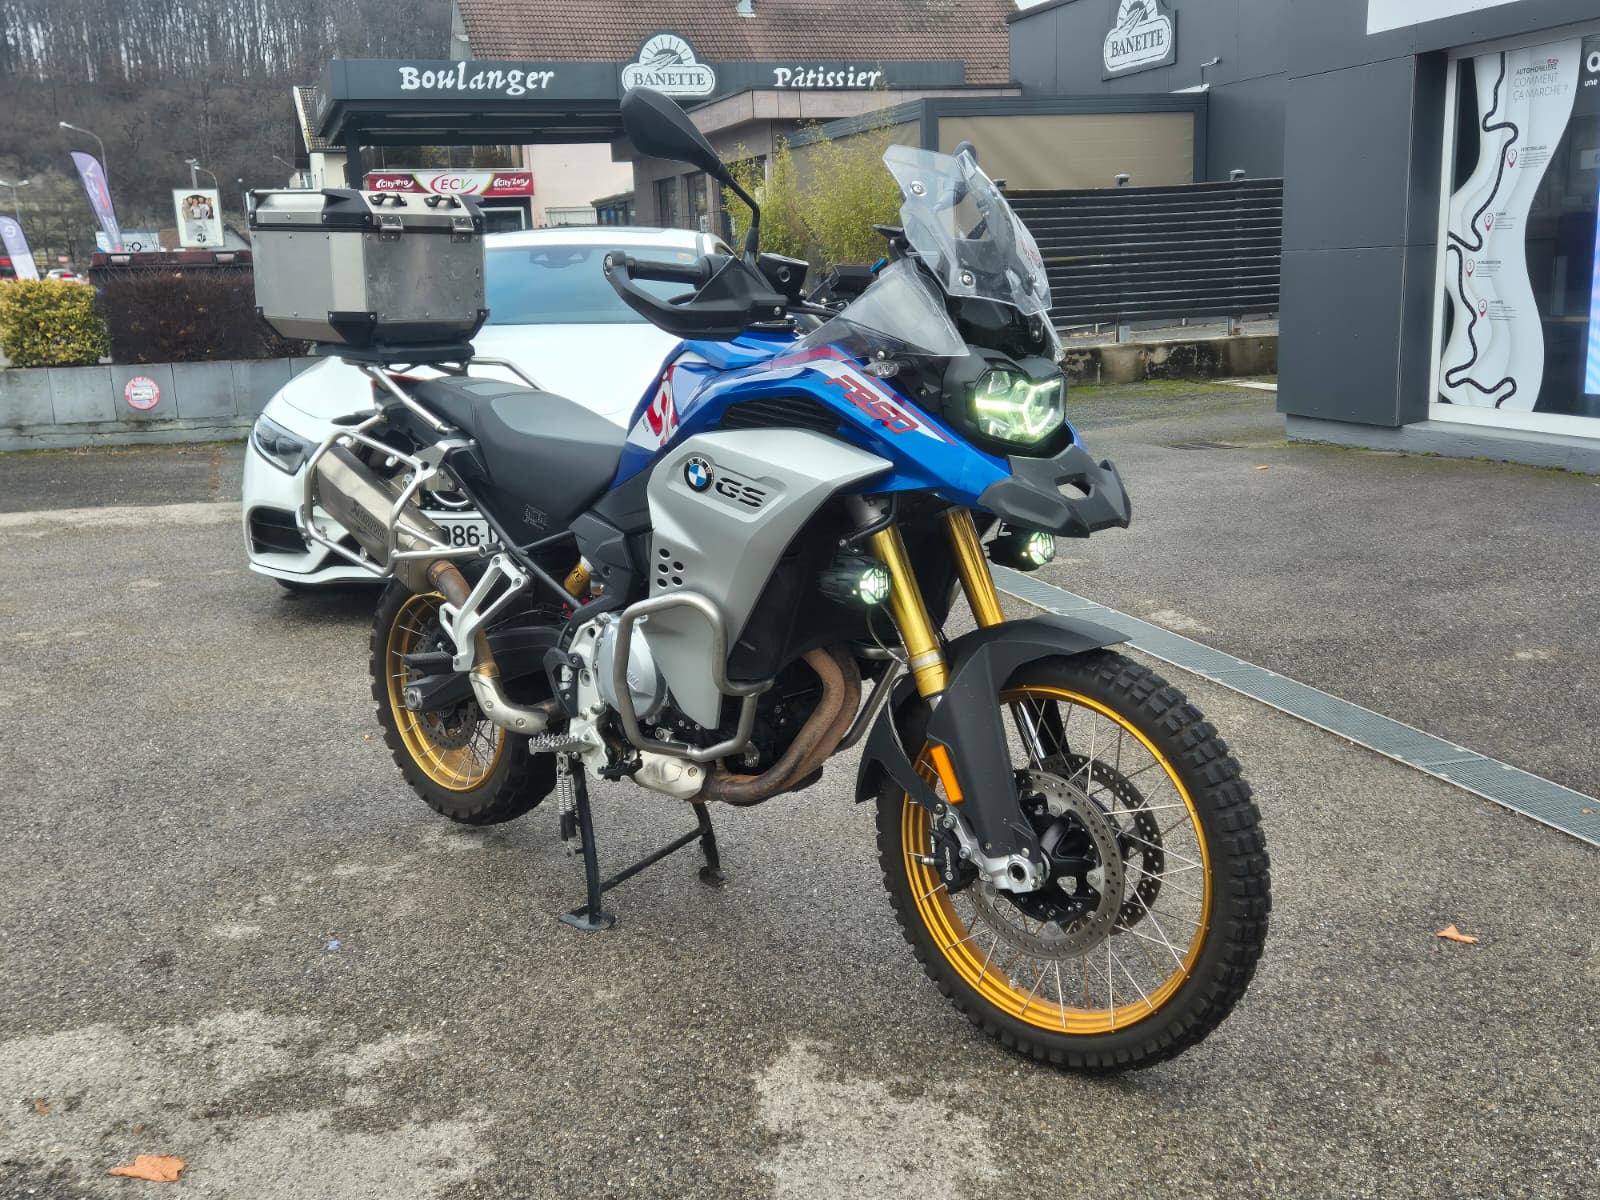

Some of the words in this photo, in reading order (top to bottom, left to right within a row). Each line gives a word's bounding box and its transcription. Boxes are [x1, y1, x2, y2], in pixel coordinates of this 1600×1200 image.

[1110, 28, 1164, 58] BANETTE
[398, 61, 555, 96] Boulanger
[632, 72, 706, 86] BANETTE
[773, 65, 882, 87] Pâtissier
[1513, 72, 1559, 88] COMMENT
[1584, 78, 1598, 87] une
[440, 178, 473, 190] ECV
[715, 477, 767, 508] GS
